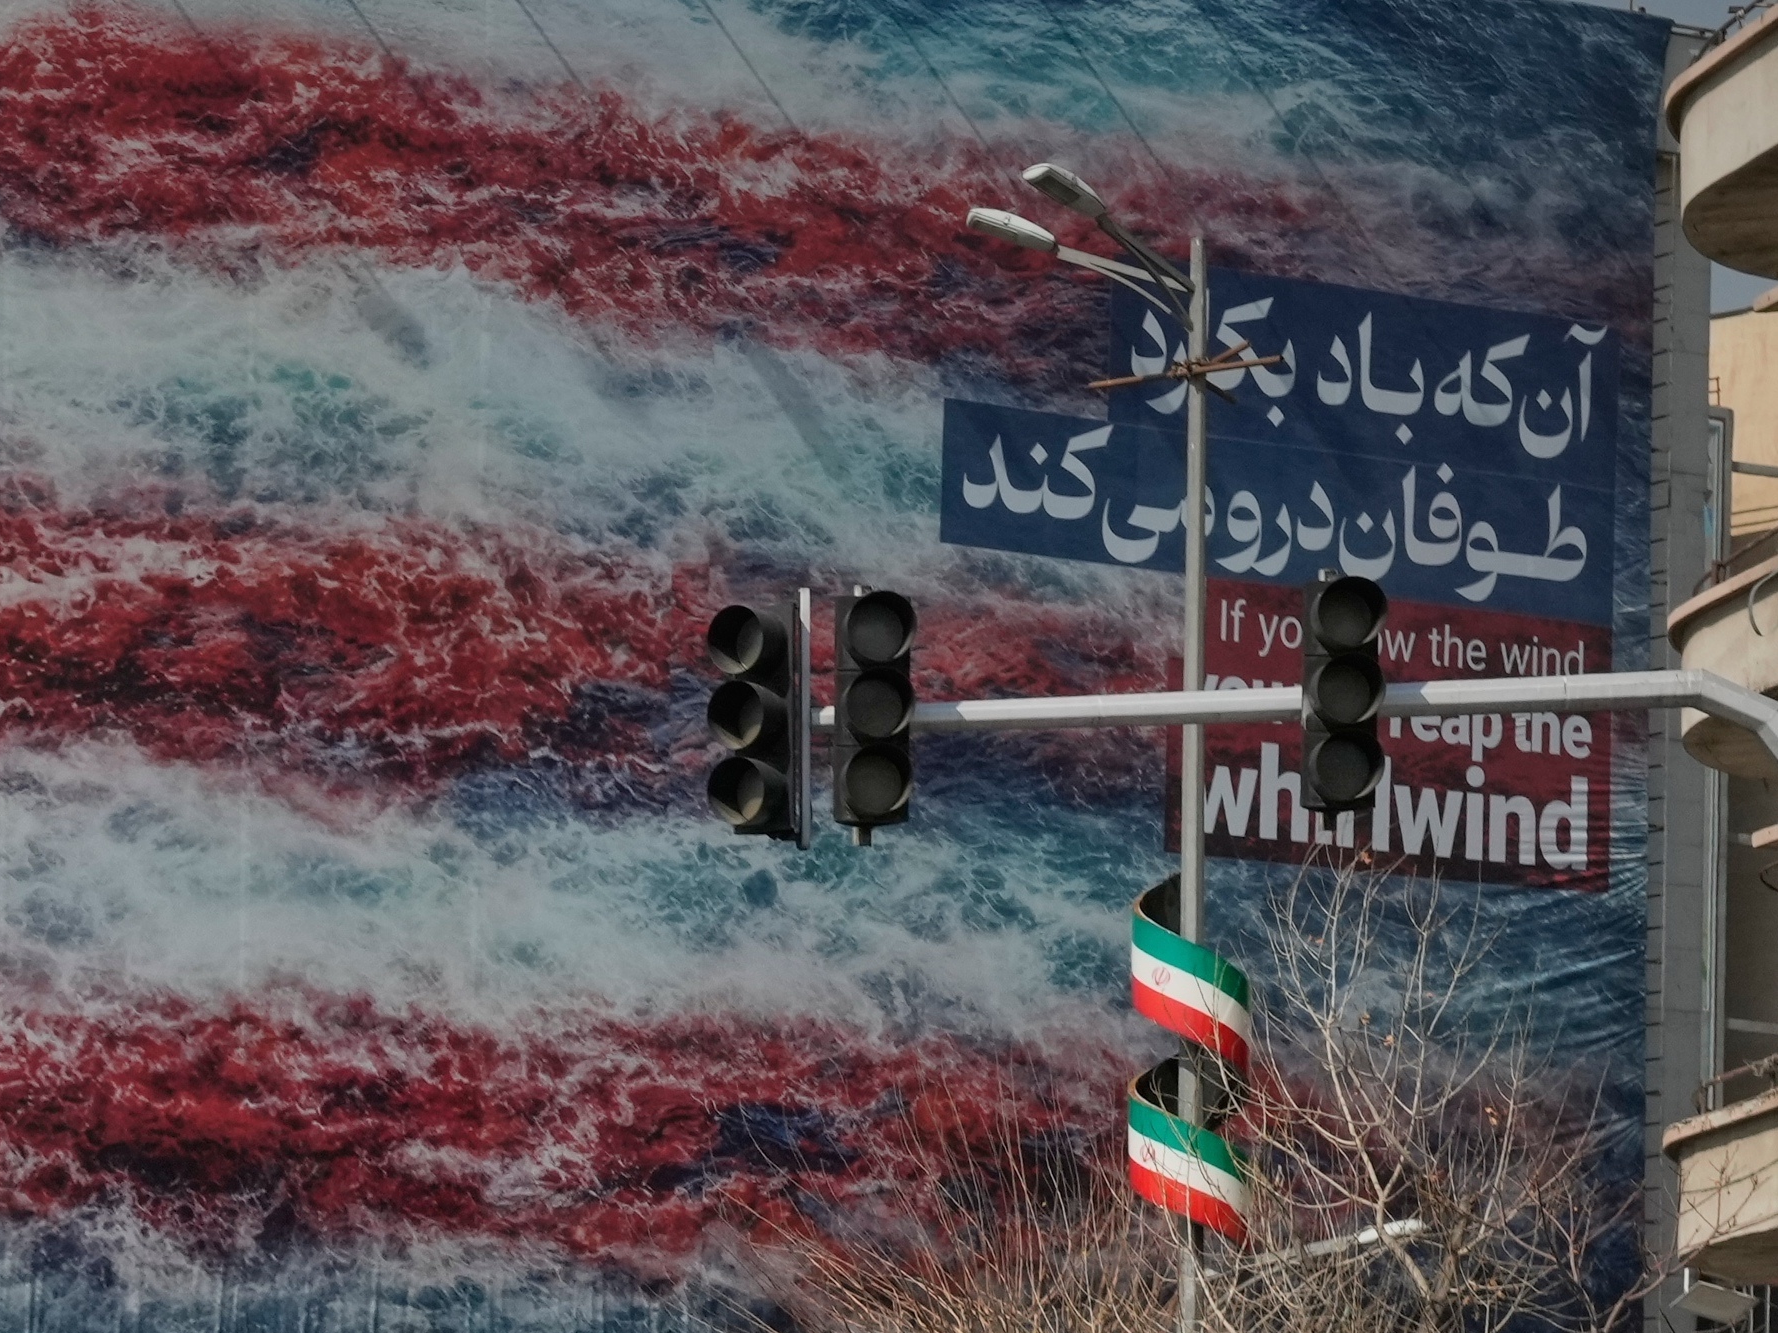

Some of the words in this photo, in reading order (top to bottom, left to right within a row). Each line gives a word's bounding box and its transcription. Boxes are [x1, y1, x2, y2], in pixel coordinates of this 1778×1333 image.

[1129, 287, 1298, 428] بکرد
[1315, 310, 1426, 446] باد
[1432, 333, 1533, 428] که
[1517, 322, 1609, 460] آن
[1213, 479, 1336, 578] درو
[1337, 461, 1588, 604] طوفان
[1220, 599, 1245, 643] If
[1259, 614, 1304, 658] yo
[1428, 623, 1487, 671] the
[1501, 635, 1585, 678] wind
